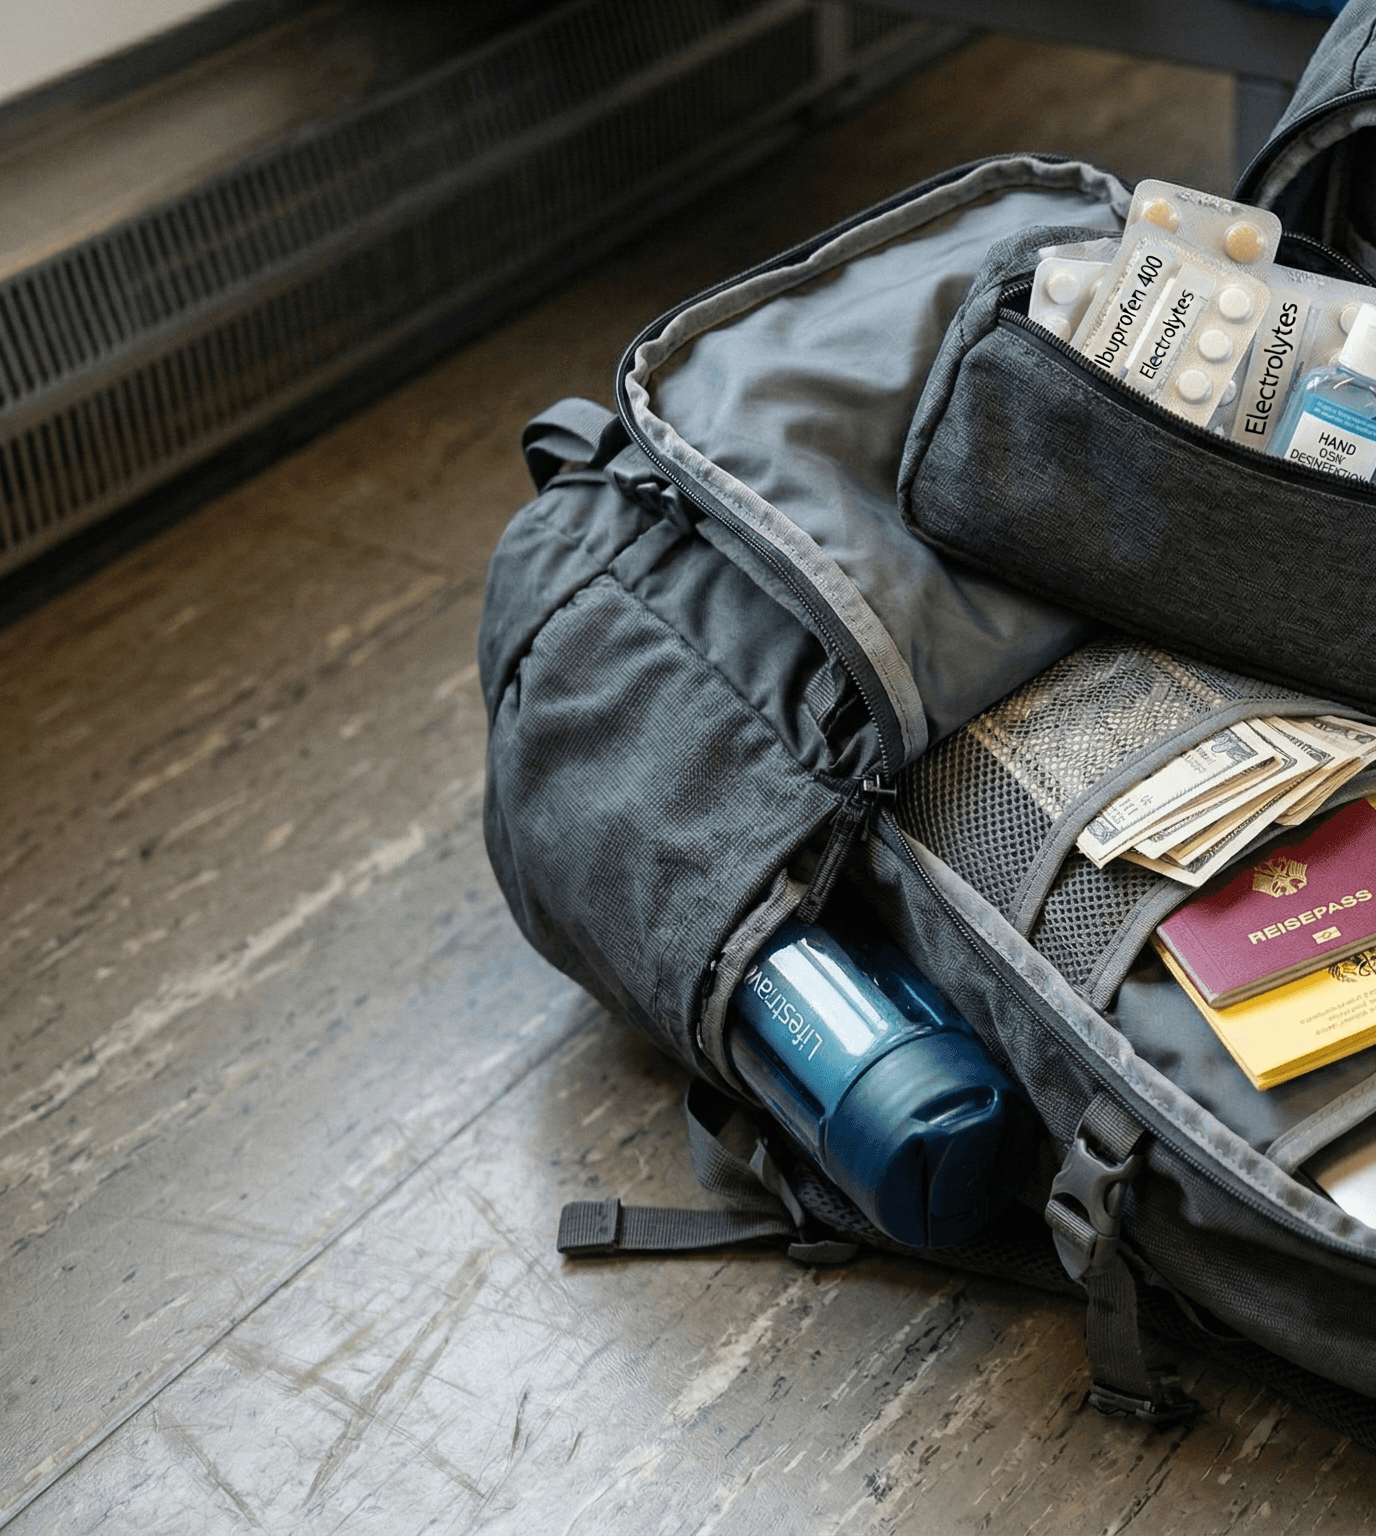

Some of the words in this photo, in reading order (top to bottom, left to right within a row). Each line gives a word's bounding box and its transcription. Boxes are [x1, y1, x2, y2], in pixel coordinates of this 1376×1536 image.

[1094, 289, 1147, 369] Ibuprofen
[1137, 255, 1163, 288] 400
[1139, 289, 1194, 379] Electrolytes
[1245, 302, 1298, 435] Electrolytes
[1318, 432, 1357, 456] HAND
[1248, 889, 1373, 944] REISEPASS
